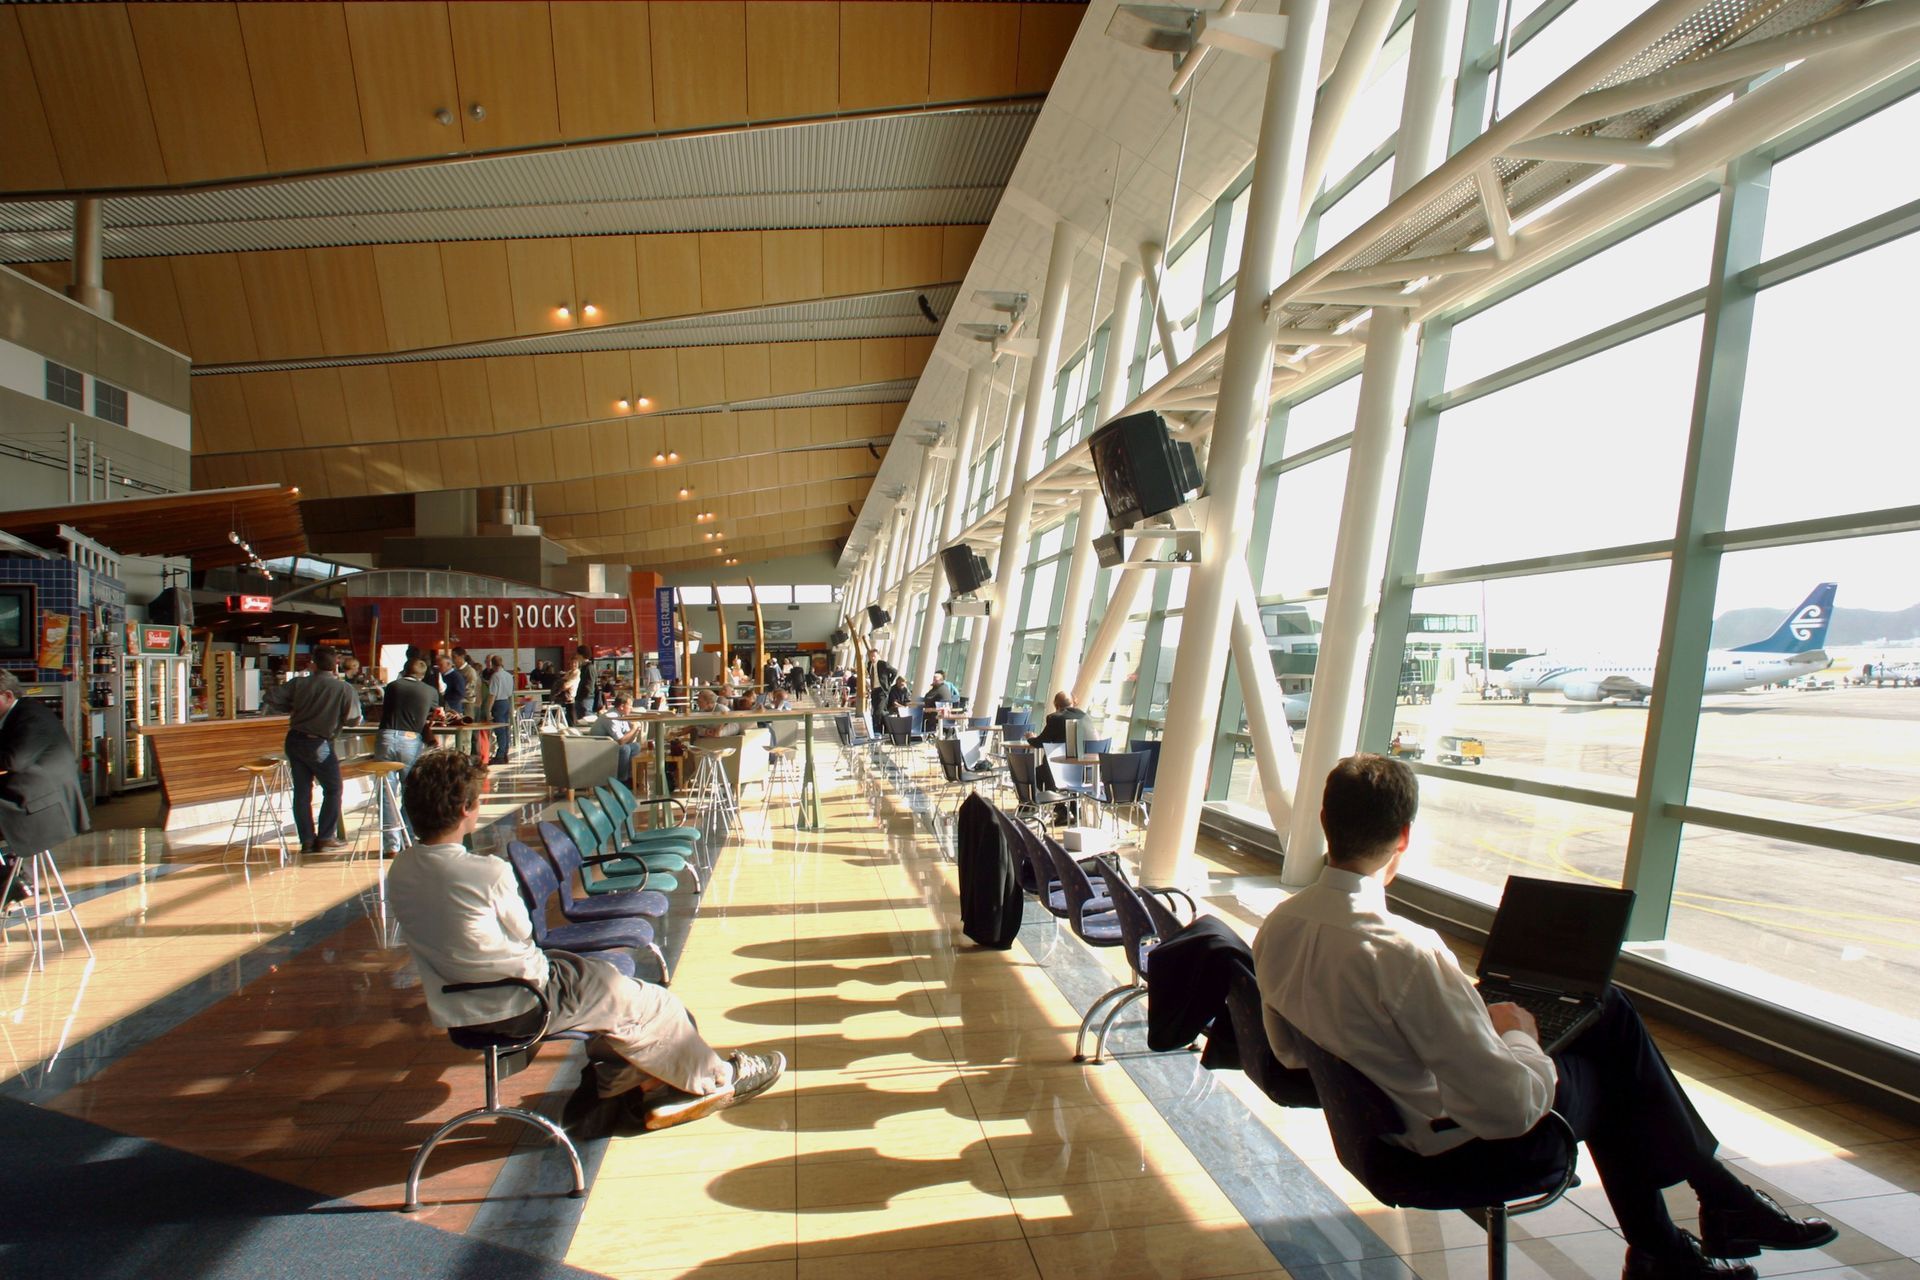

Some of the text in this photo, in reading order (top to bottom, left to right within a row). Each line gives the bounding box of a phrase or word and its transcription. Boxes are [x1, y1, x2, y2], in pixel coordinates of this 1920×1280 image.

[459, 604, 577, 629] RED ROCKS
[215, 653, 225, 717] LINDAUER
